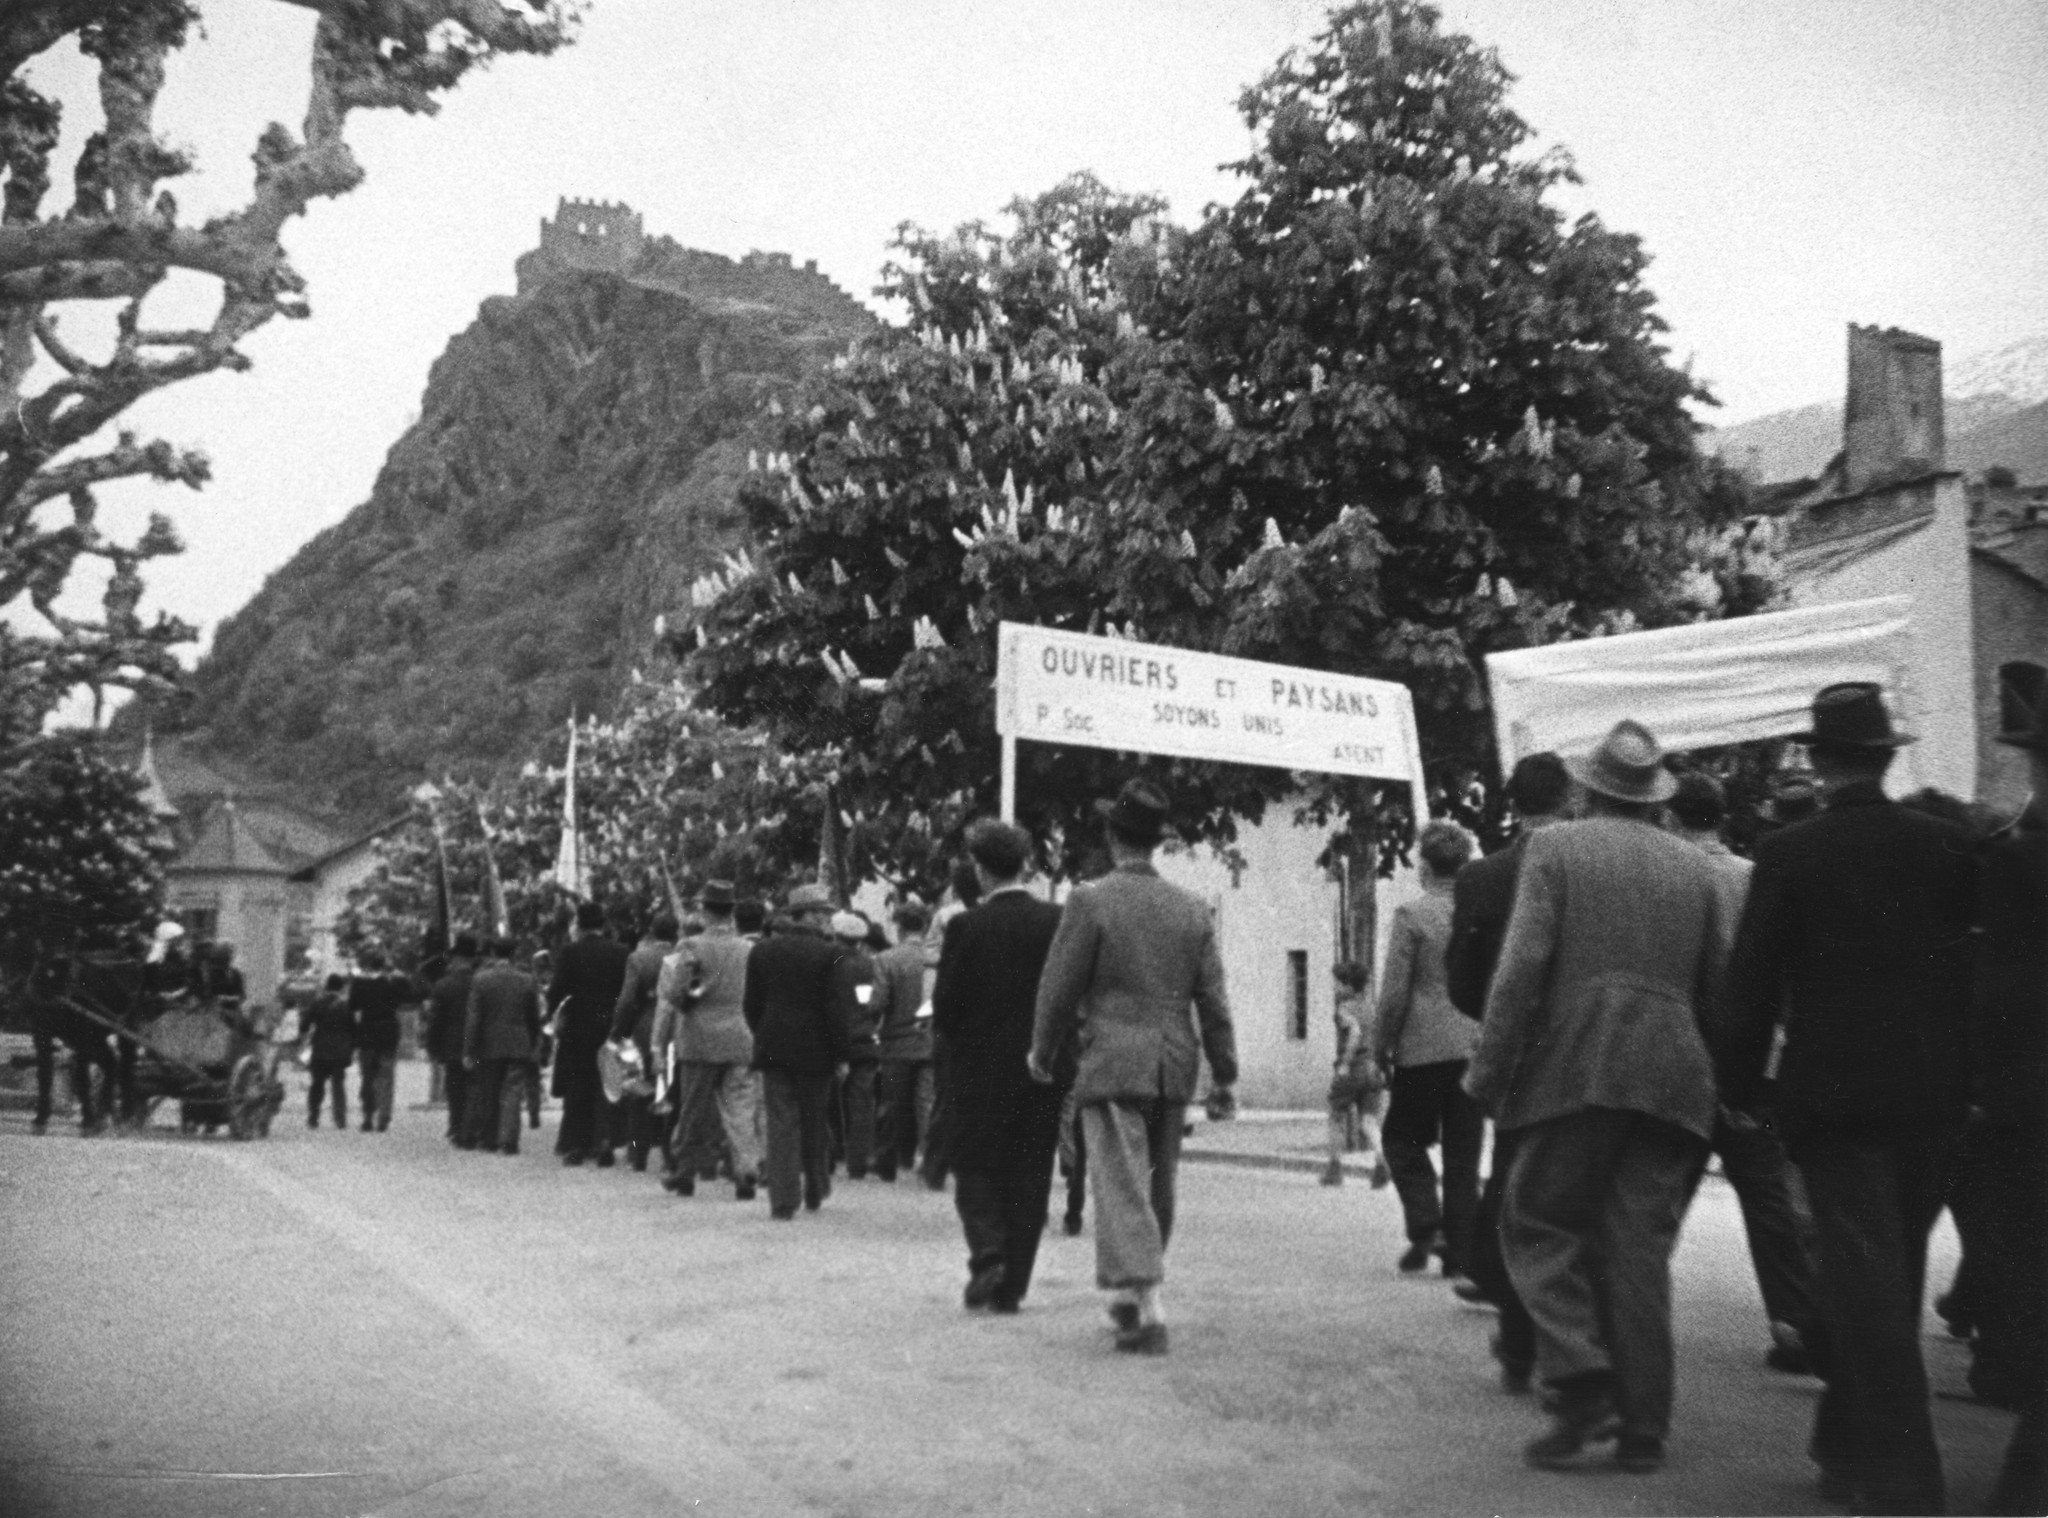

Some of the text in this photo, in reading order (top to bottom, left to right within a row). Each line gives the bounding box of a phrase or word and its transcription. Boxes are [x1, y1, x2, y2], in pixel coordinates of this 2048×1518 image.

[1042, 646, 1379, 719] OUVRIERS ET PAYSANS
[1037, 702, 1049, 723] P
[1153, 703, 1284, 736] SOYONS UNIS
